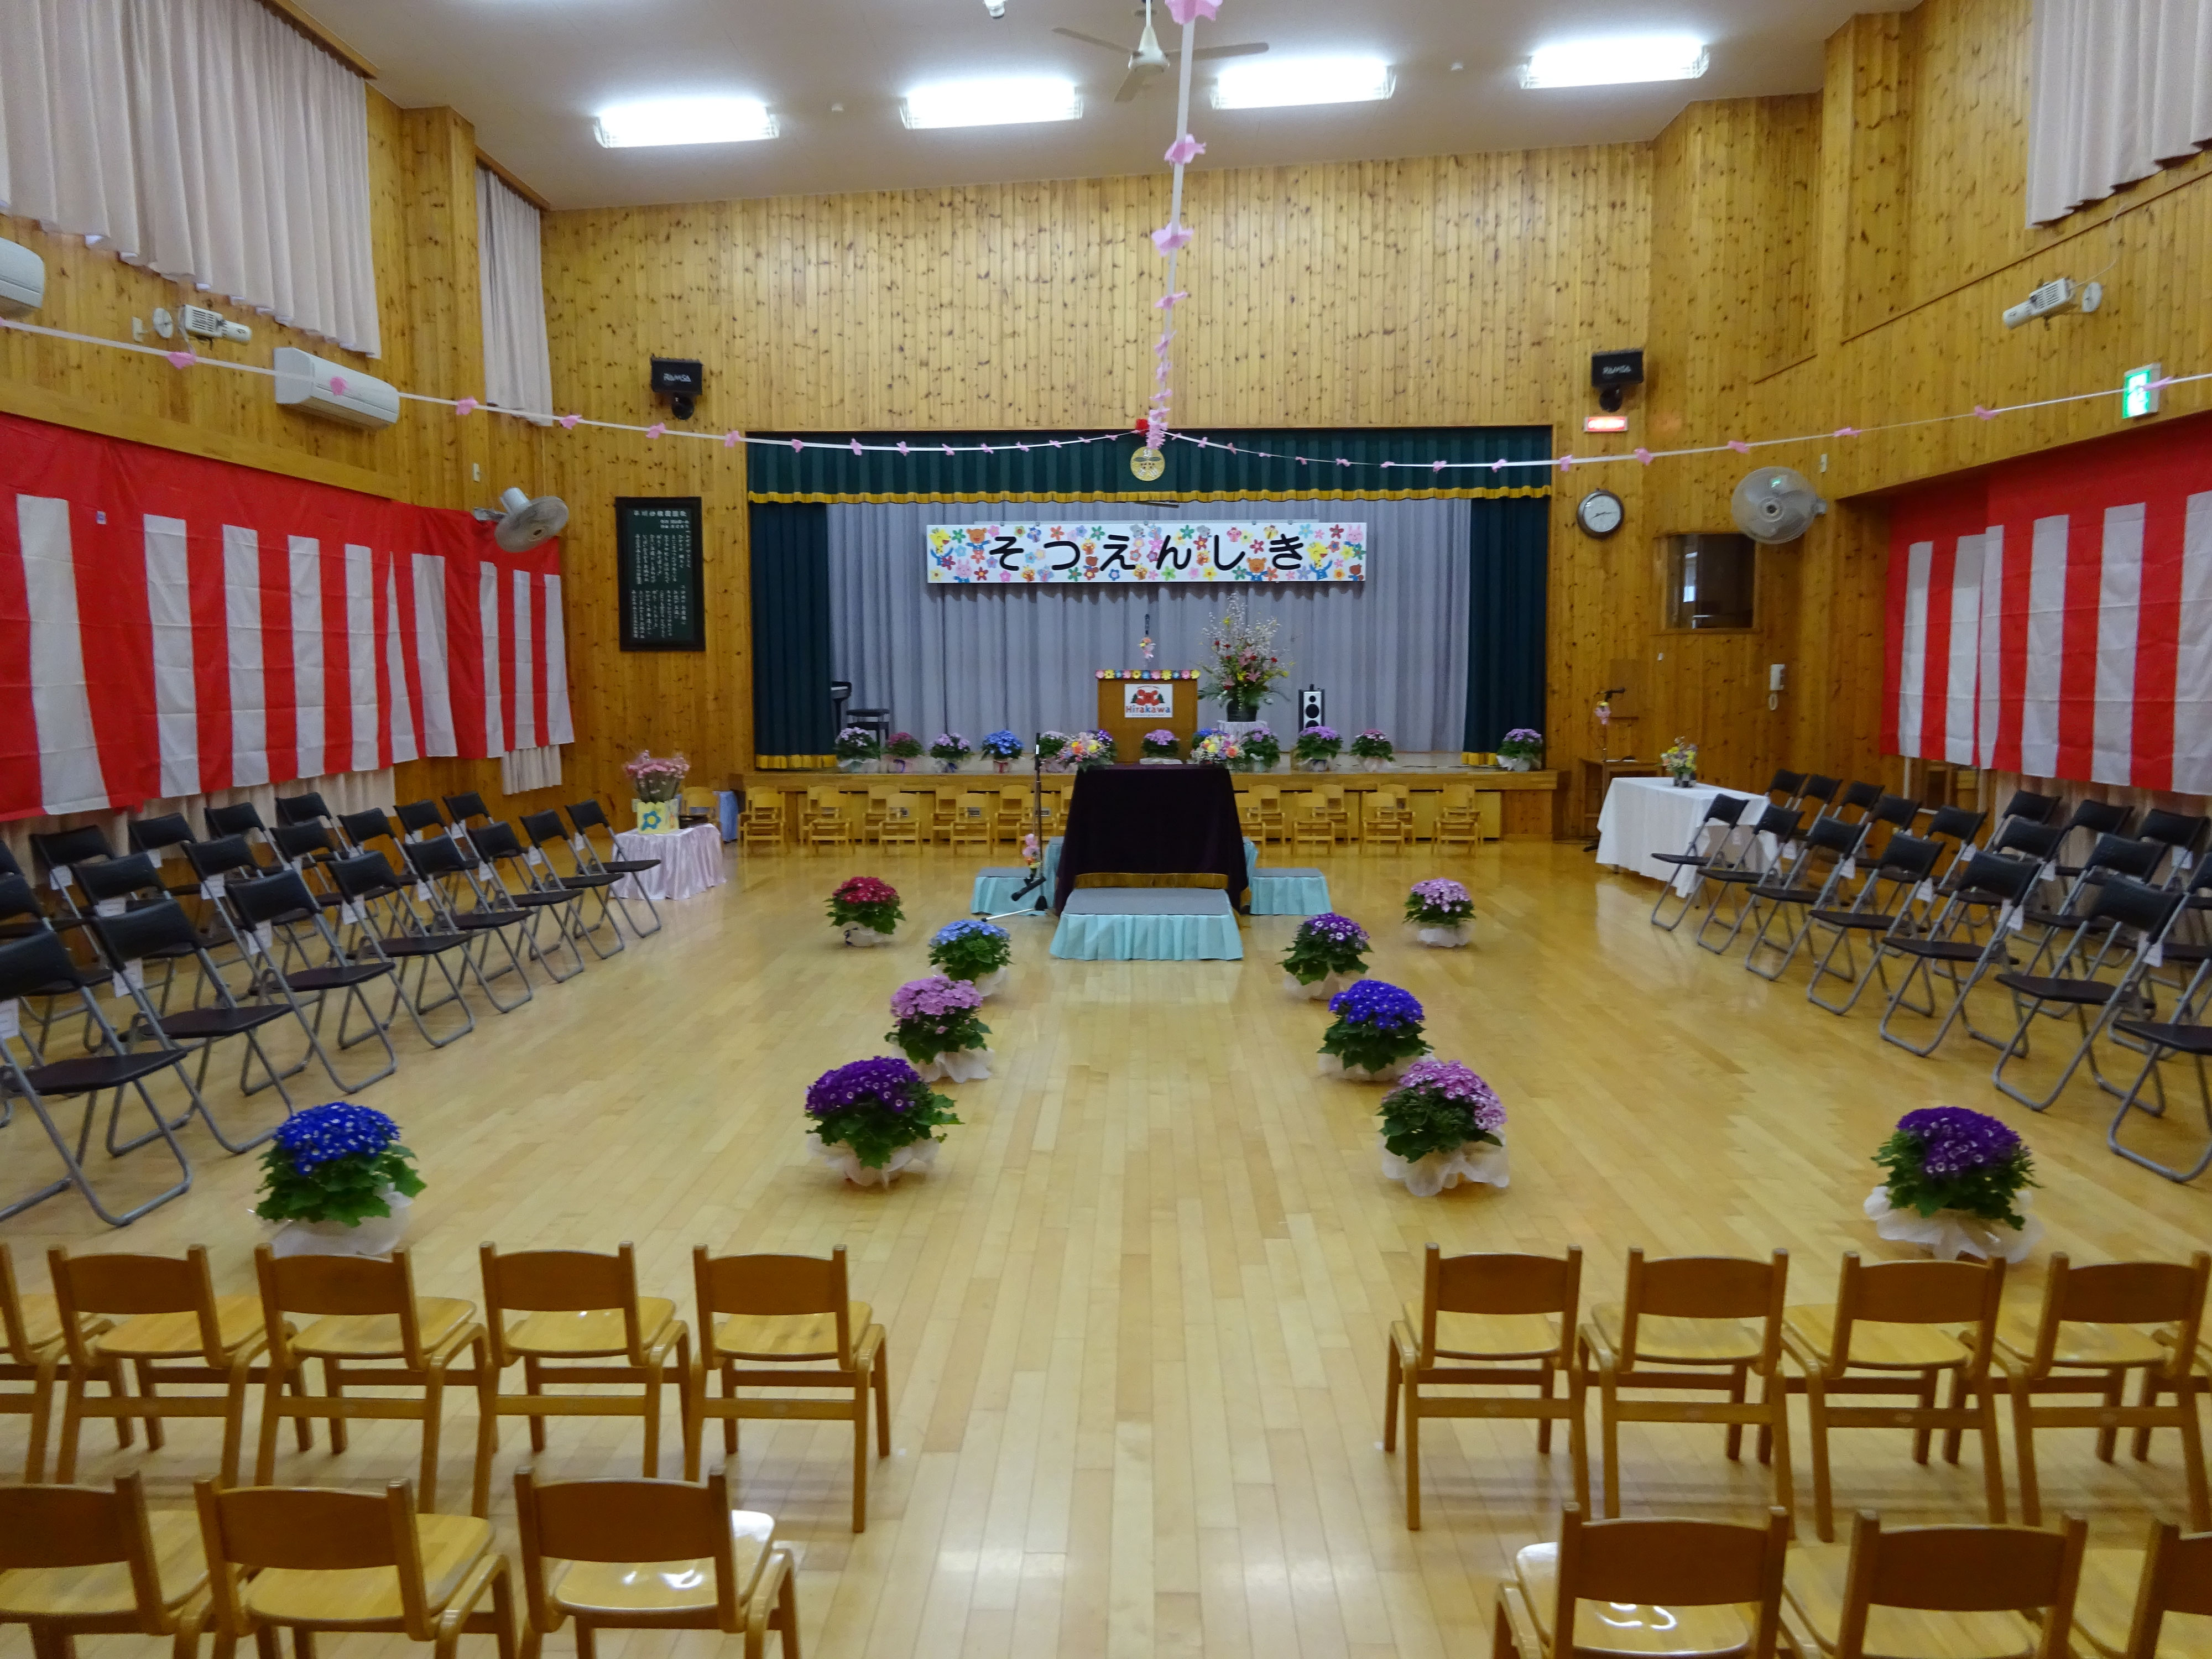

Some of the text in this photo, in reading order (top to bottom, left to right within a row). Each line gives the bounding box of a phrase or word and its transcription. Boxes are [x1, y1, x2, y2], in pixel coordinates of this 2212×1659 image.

[989, 534, 1305, 571] そつえんしき
[1125, 705, 1171, 713] Hirakawa
